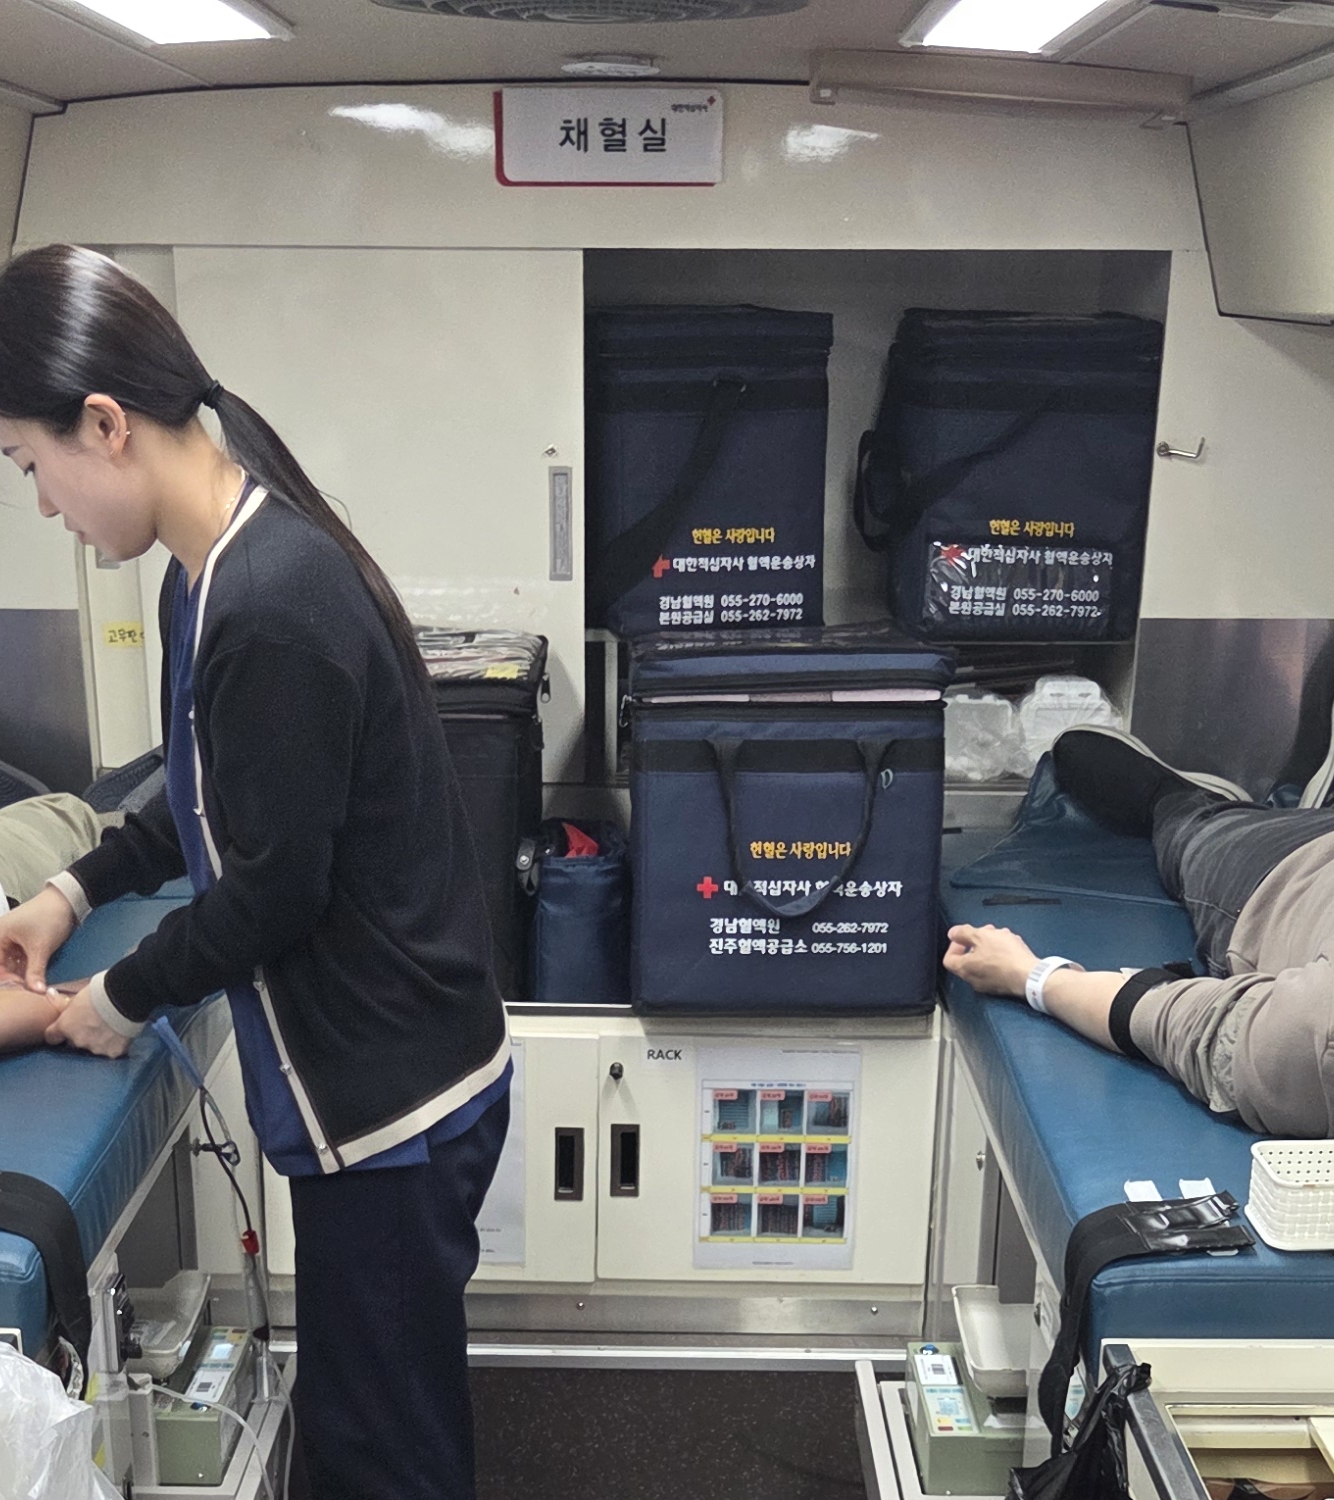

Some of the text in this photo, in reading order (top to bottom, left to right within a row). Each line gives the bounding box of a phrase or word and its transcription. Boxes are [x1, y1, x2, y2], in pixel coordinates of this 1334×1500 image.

[559, 117, 668, 153] 채혈실
[691, 526, 776, 545] 헌혈은 사랑입니다
[988, 519, 1075, 538] 헌혈은 사랑입니다
[672, 554, 816, 573] 대한적십자사 혈액운송상자
[968, 546, 1113, 567] 대한적십자사 혈액운송상자
[720, 592, 804, 608] 055-270-6000
[1013, 589, 1100, 602] 055-270-6000
[720, 608, 803, 623] 055-262-7972
[1012, 604, 1099, 618] 055-262-7972
[750, 841, 852, 860] 헌혈은 사랑입니다
[723, 880, 812, 897] 대적십자사
[709, 917, 889, 935] 경남혈액원 055-262-7972
[708, 938, 808, 955] 진주혈액공급소
[646, 1048, 683, 1061] RACK
